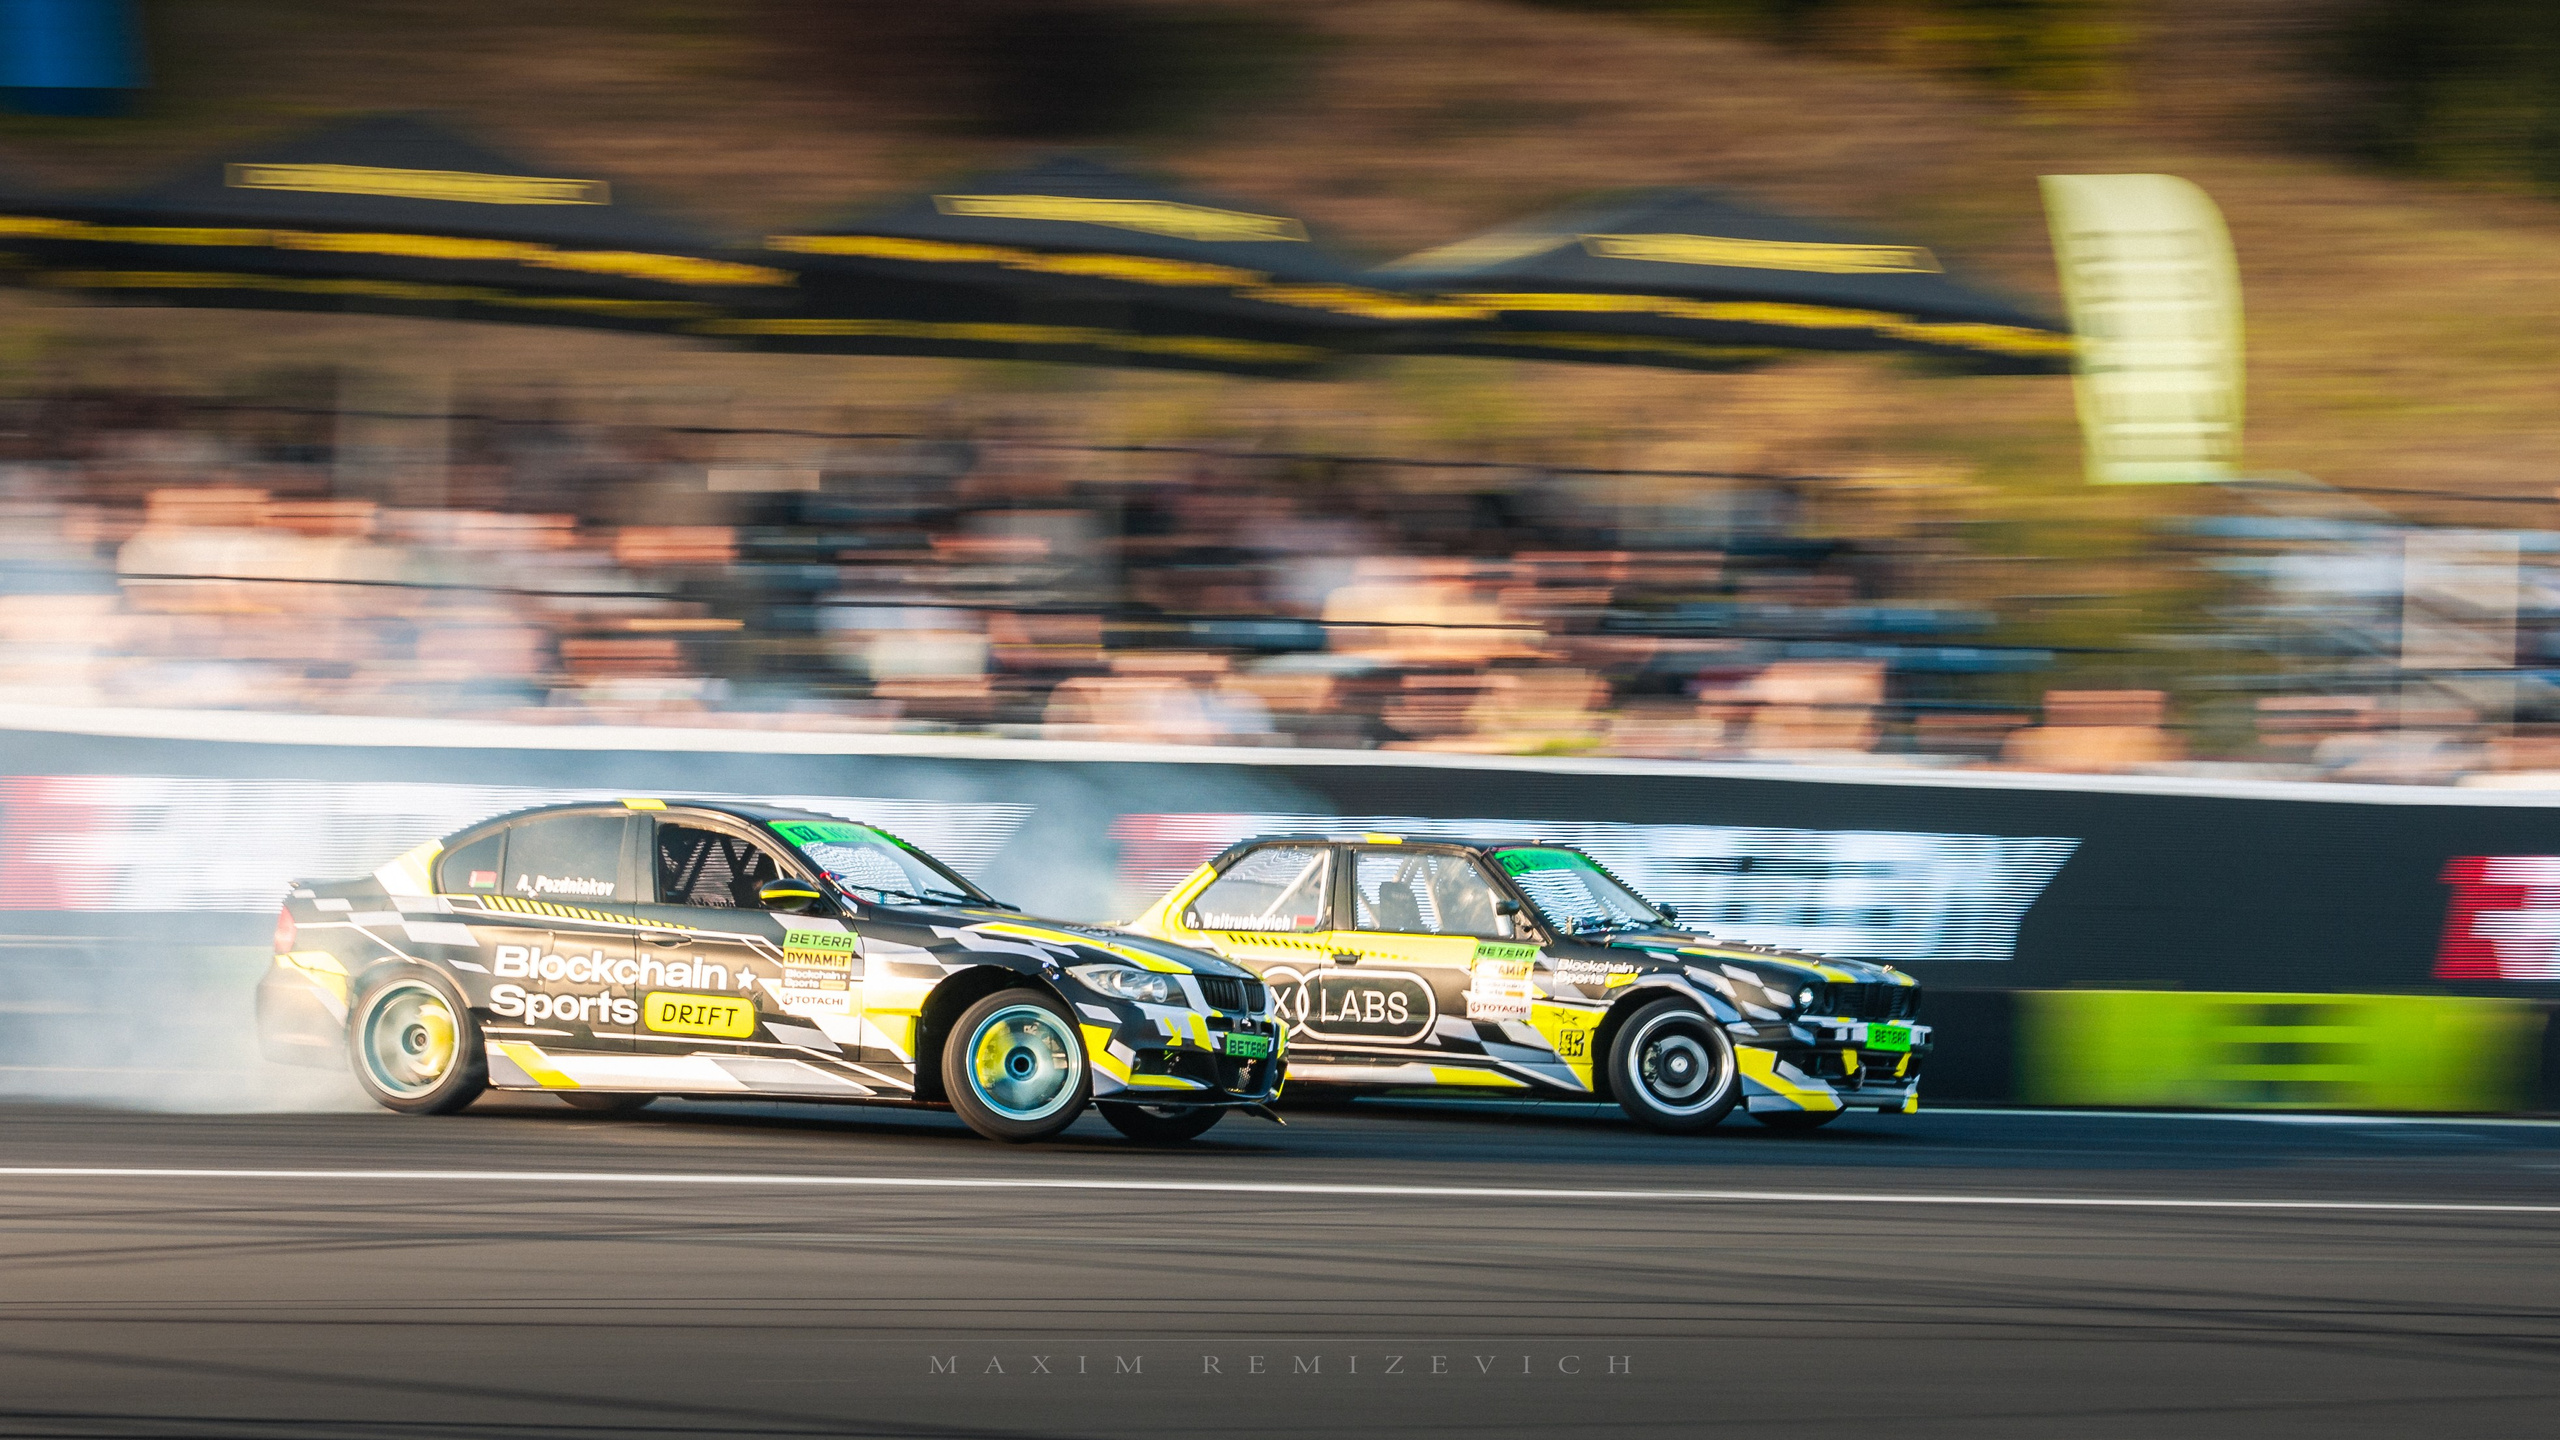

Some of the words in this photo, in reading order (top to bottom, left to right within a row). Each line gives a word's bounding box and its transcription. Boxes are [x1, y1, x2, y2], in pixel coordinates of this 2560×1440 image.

[534, 875, 615, 897] Pozdniakov
[1186, 911, 1200, 929] R.
[493, 945, 728, 989] Blockchain
[1557, 958, 1635, 974] Blockchain
[1552, 971, 1605, 986] Sports
[488, 984, 639, 1026] Sports
[662, 1003, 739, 1027] DRIFT
[795, 996, 843, 1006] TOTACHI
[1320, 989, 1409, 1025] LABS
[1483, 1003, 1527, 1014] TOTACHI
